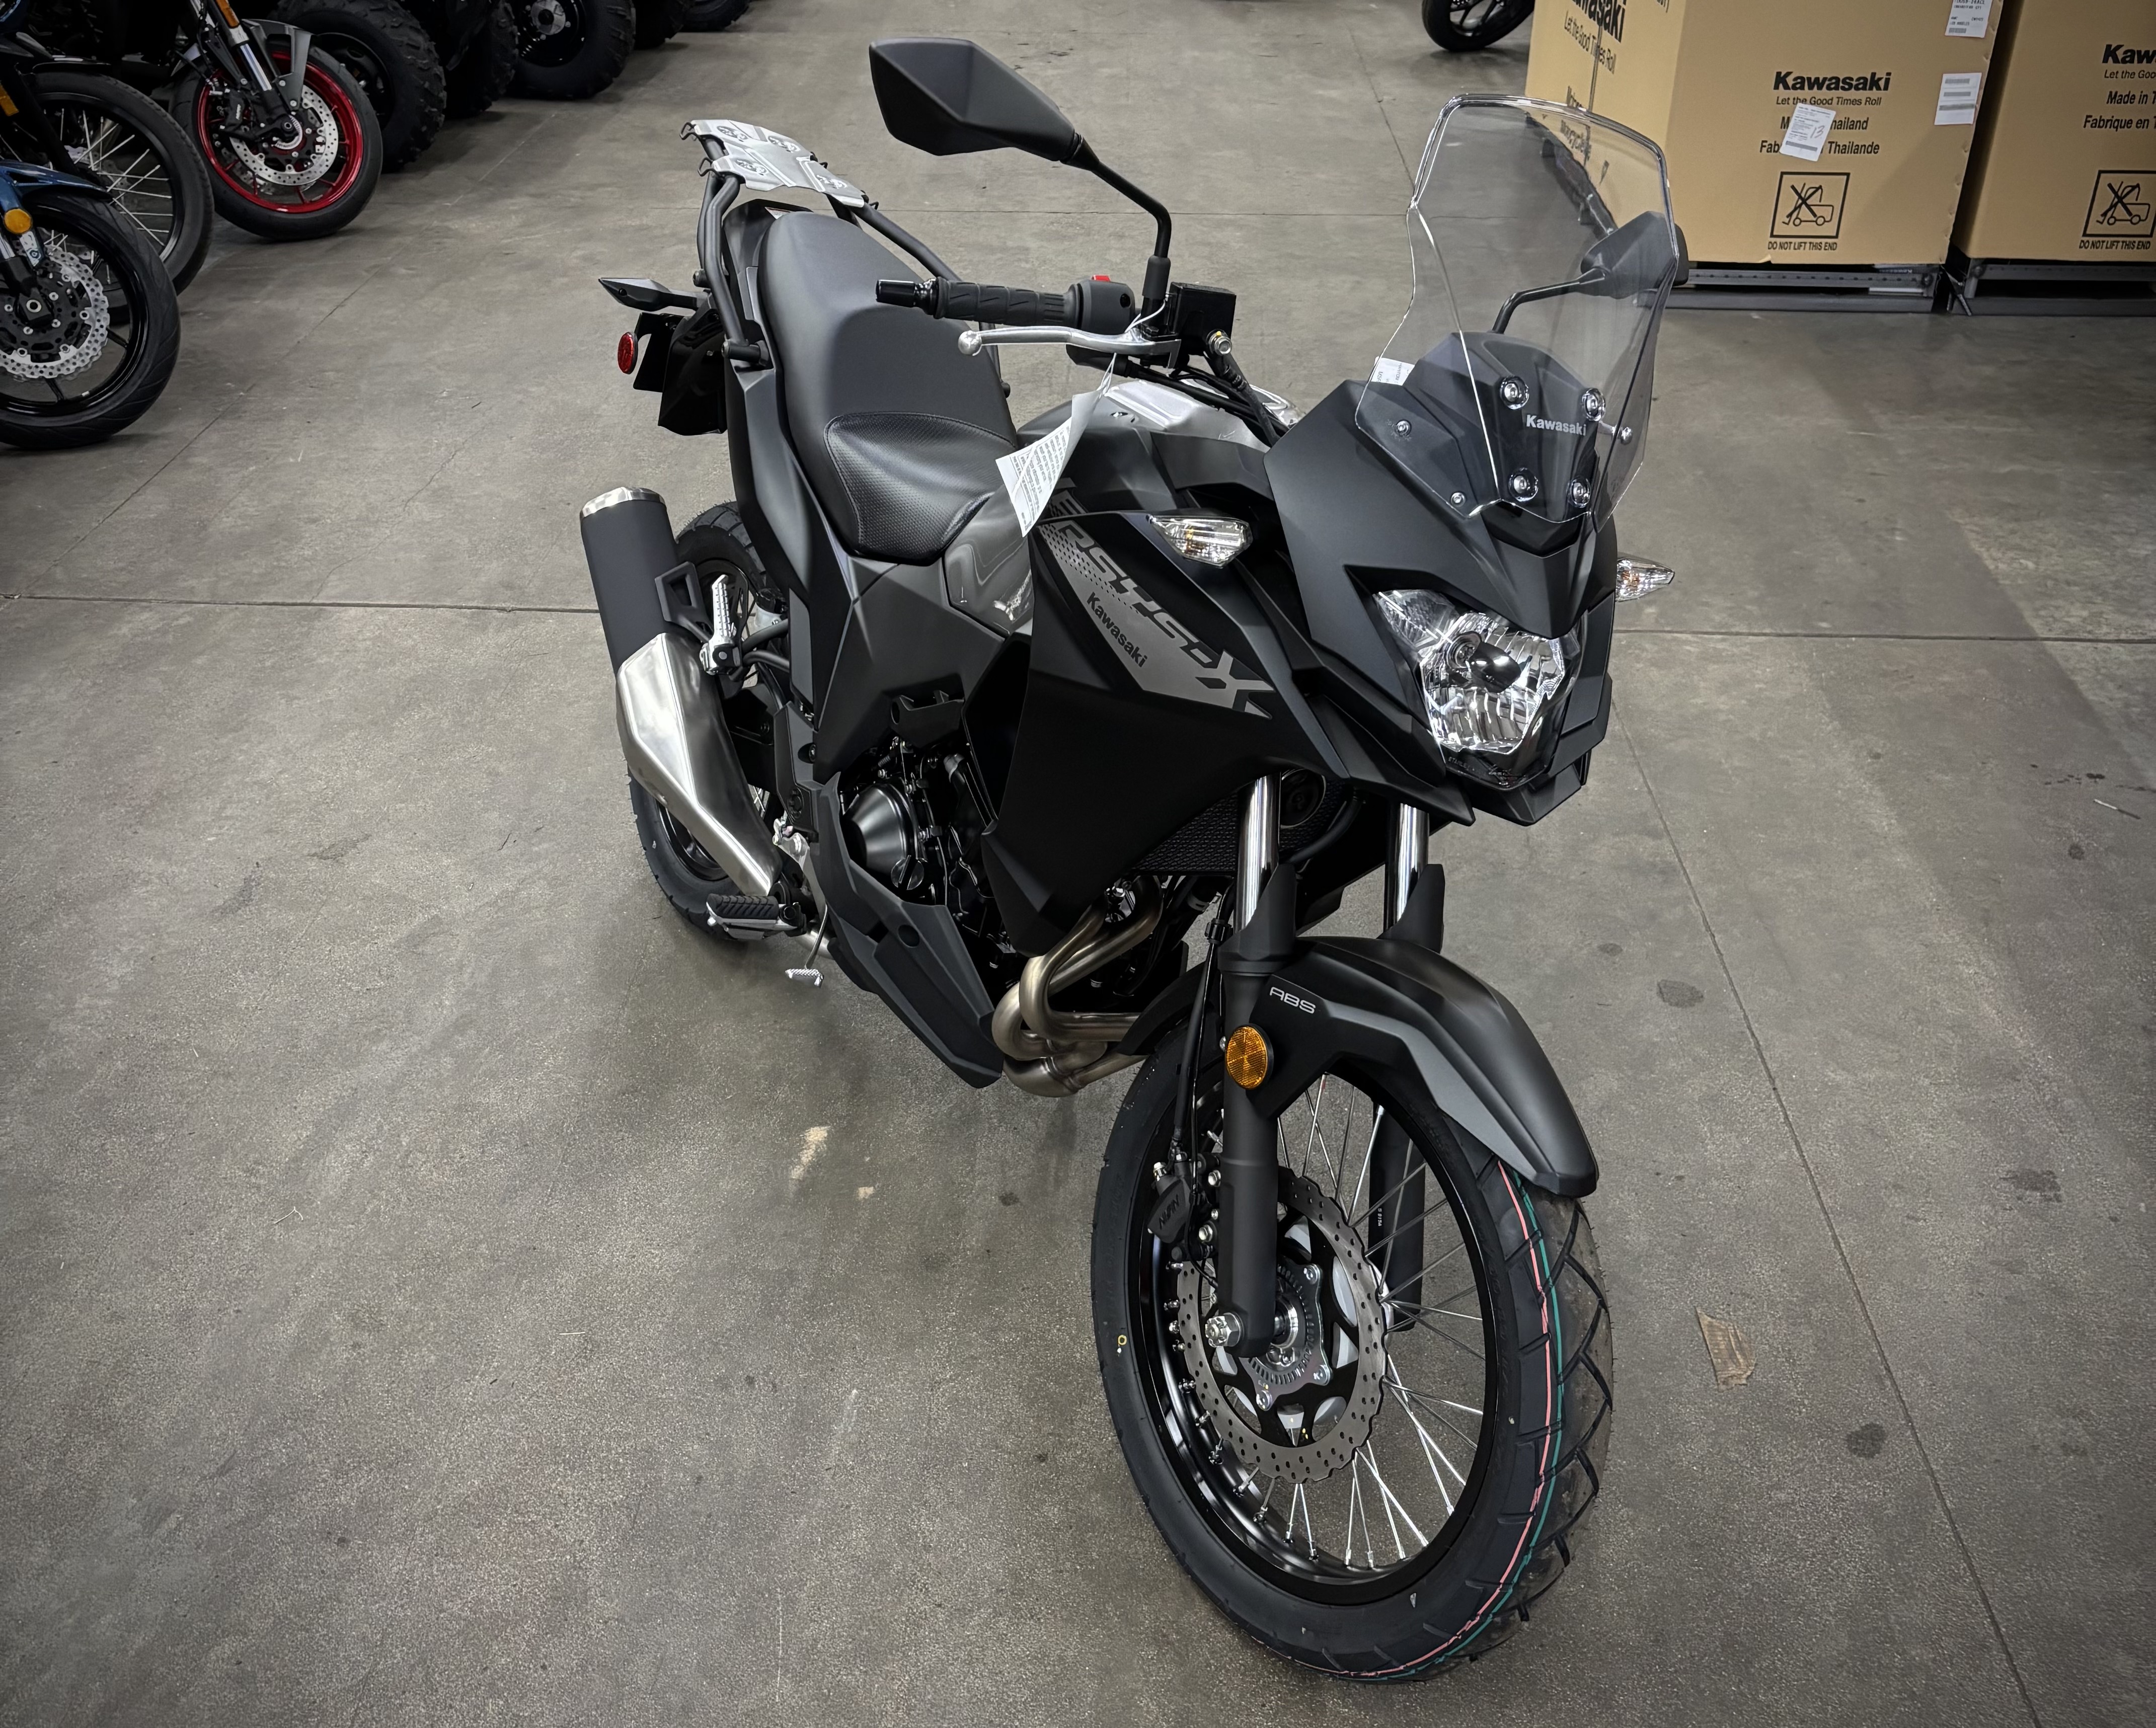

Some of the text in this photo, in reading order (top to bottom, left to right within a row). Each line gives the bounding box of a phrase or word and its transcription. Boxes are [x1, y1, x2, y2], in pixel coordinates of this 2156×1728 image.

[1569, 0, 1627, 43] wasaki
[2102, 44, 2156, 64] Kaw
[1774, 71, 1891, 91] Kawasaki
[2104, 69, 2156, 79] Let the Goo
[1776, 96, 1882, 106] Let the Good Times Roll
[2106, 91, 2136, 105] Made
[2138, 91, 2148, 105] in
[2083, 115, 2133, 132] Fabrique
[2135, 118, 2150, 129] en
[1828, 141, 1880, 154] Thailande
[1768, 242, 1837, 251] DO NOT LIFT THIS END
[2079, 240, 2150, 250] DO NOT LIFT THIS END
[1526, 414, 1587, 436] Kawasaki
[1087, 591, 1148, 668] Kawasaki
[1269, 986, 1316, 1014] ABS
